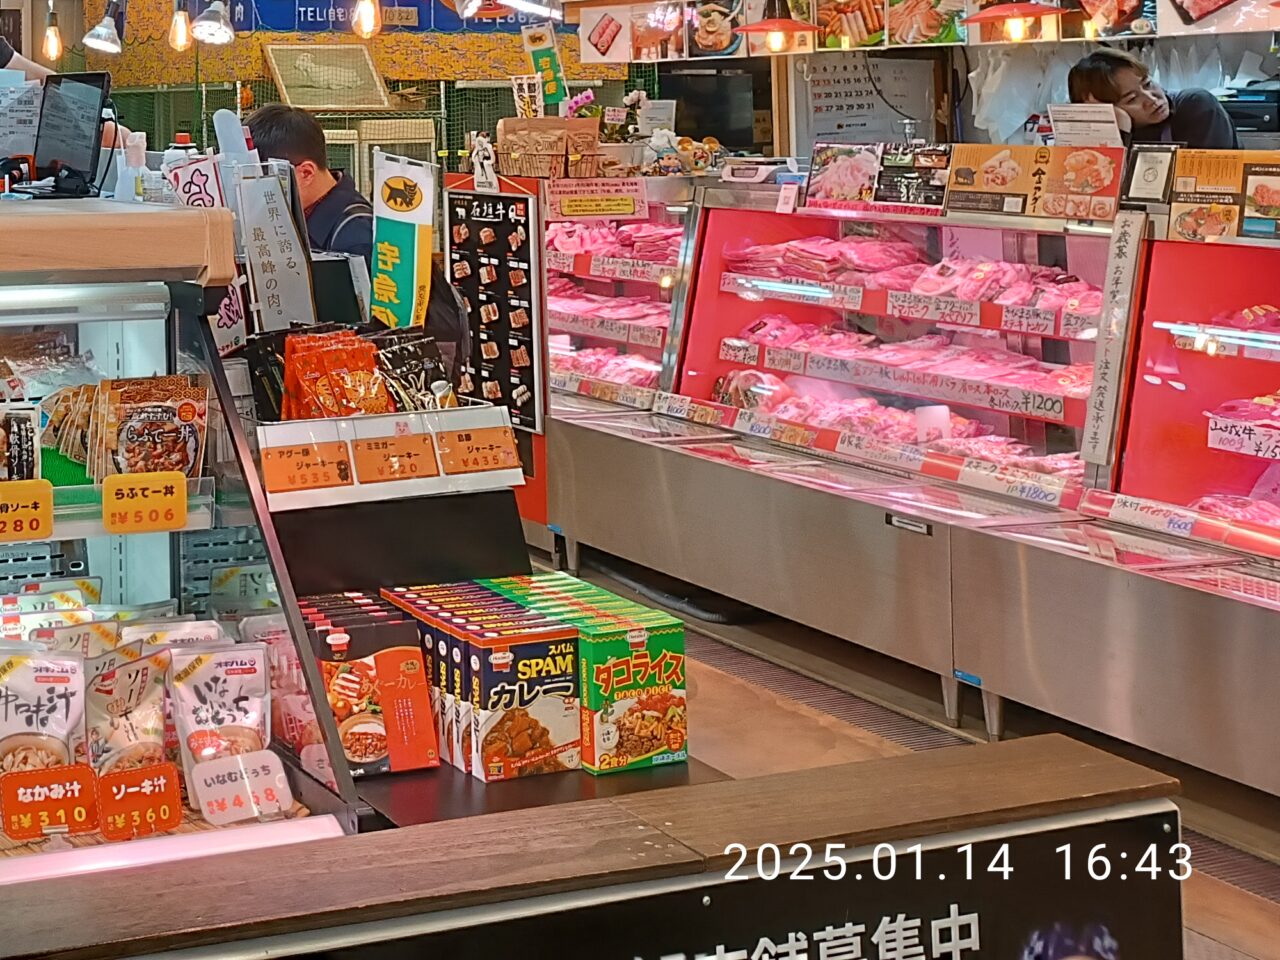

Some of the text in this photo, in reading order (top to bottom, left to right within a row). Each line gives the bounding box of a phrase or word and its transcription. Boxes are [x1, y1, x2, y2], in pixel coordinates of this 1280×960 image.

[470, 201, 506, 220] 石垣牛
[263, 190, 301, 277] 世界に誇る、
[251, 226, 284, 316] 最高峰の肉。
[1021, 391, 1064, 415] ¥1200
[126, 423, 194, 443] らふてー丼
[366, 442, 395, 450] ミミガー
[467, 444, 502, 454] ジャーキー
[461, 455, 500, 468] ¥435
[288, 472, 330, 486] ¥535
[114, 485, 176, 500] らふてー丼
[117, 508, 175, 525] ¥506
[548, 644, 574, 654] スパム
[517, 654, 573, 680] SPAM
[594, 649, 684, 696] タコライス
[487, 681, 574, 712] カレー
[16, 780, 82, 803] なかみ汁
[111, 776, 168, 800] ソーキ汁
[19, 806, 87, 828] ¥310
[114, 805, 170, 828] ¥360
